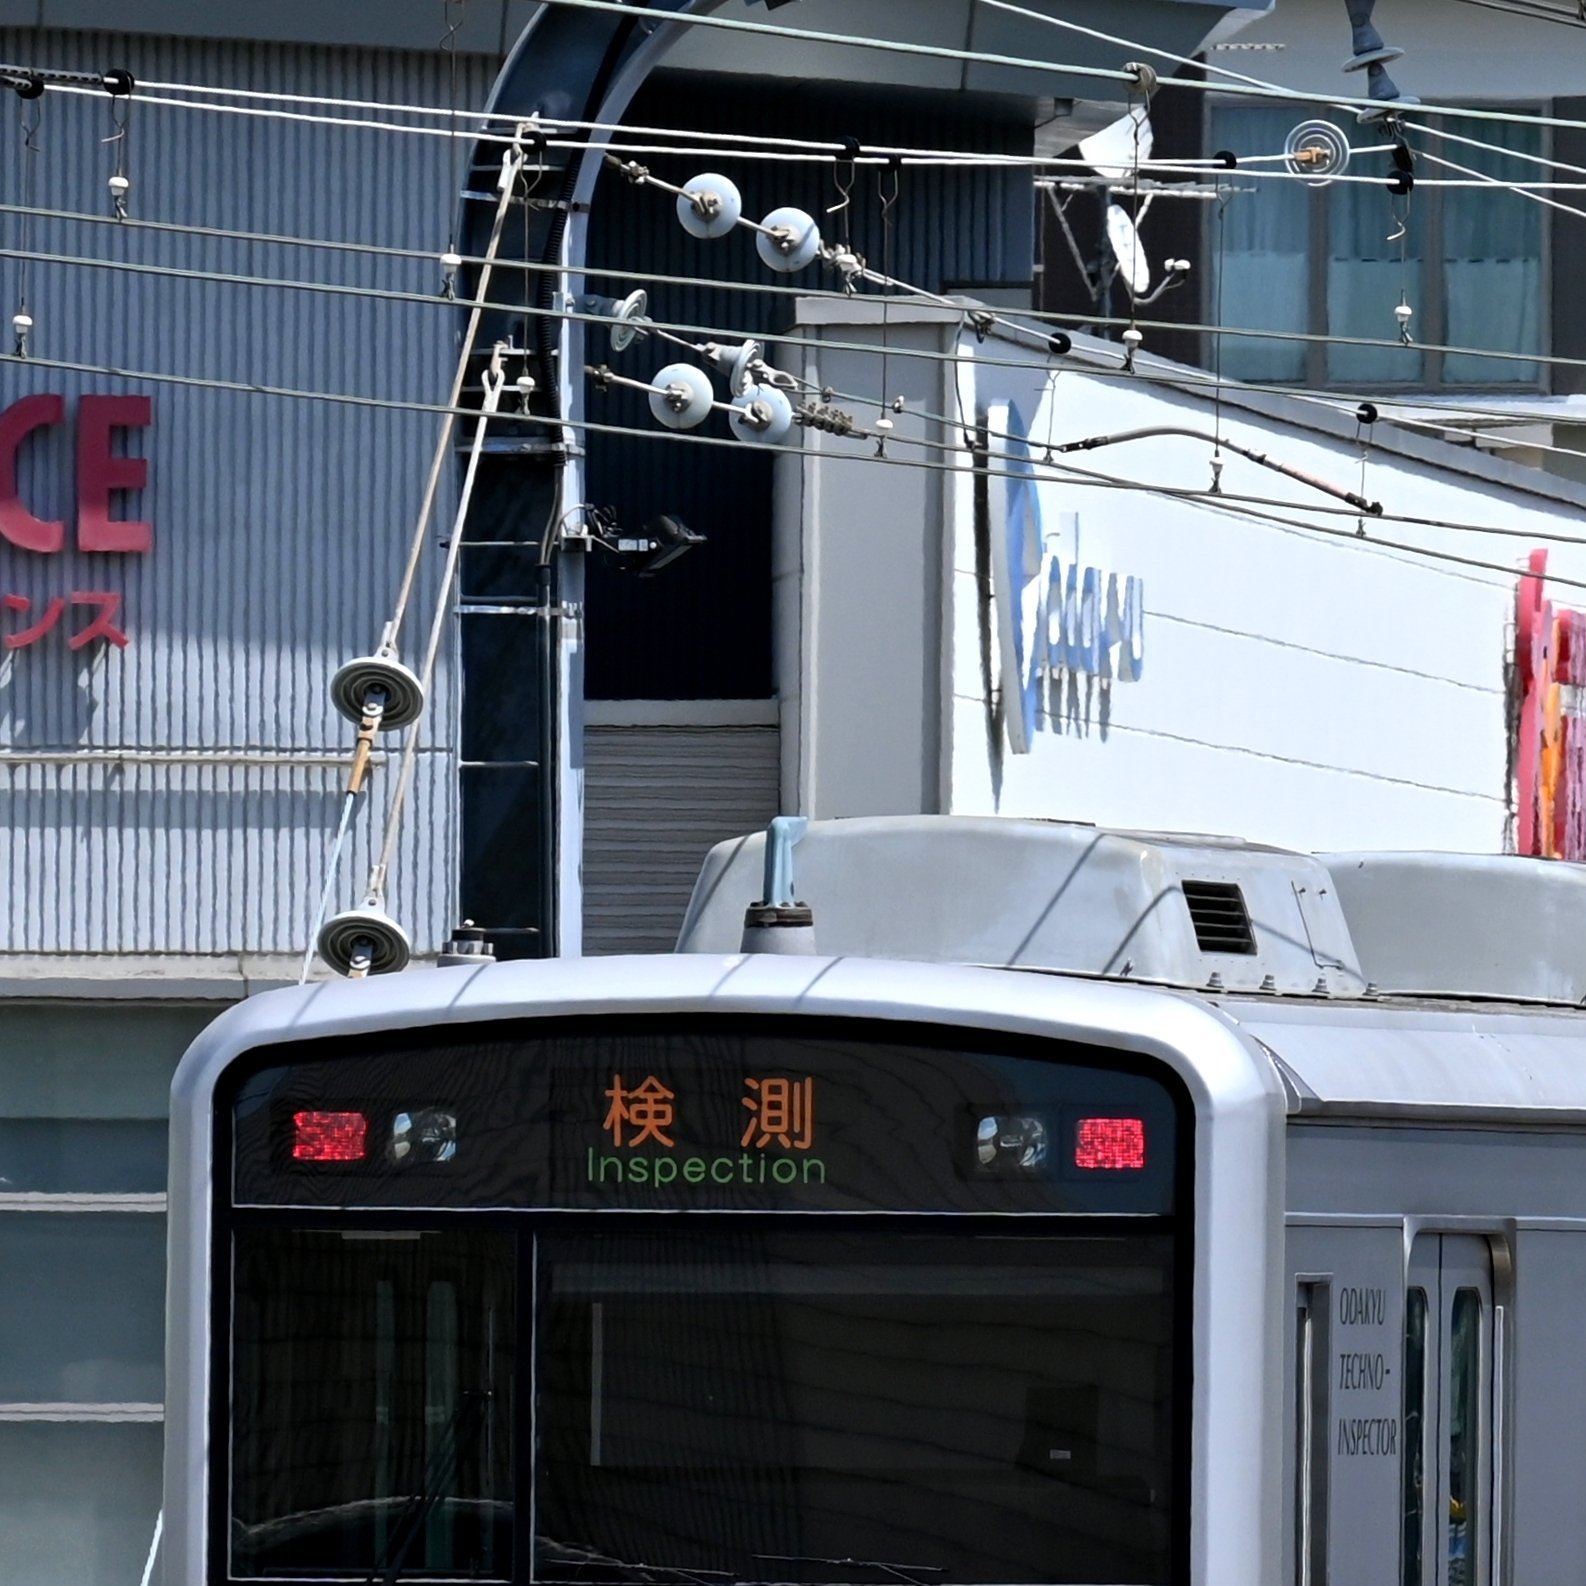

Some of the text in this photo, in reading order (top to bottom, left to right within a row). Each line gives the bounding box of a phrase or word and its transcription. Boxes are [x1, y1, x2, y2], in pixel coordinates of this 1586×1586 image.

[588, 1147, 826, 1188] Inspection
[1340, 1287, 1386, 1326] ODAKYU
[1340, 1353, 1391, 1390] TECHNO-
[1337, 1418, 1397, 1456] INSPECTOR
